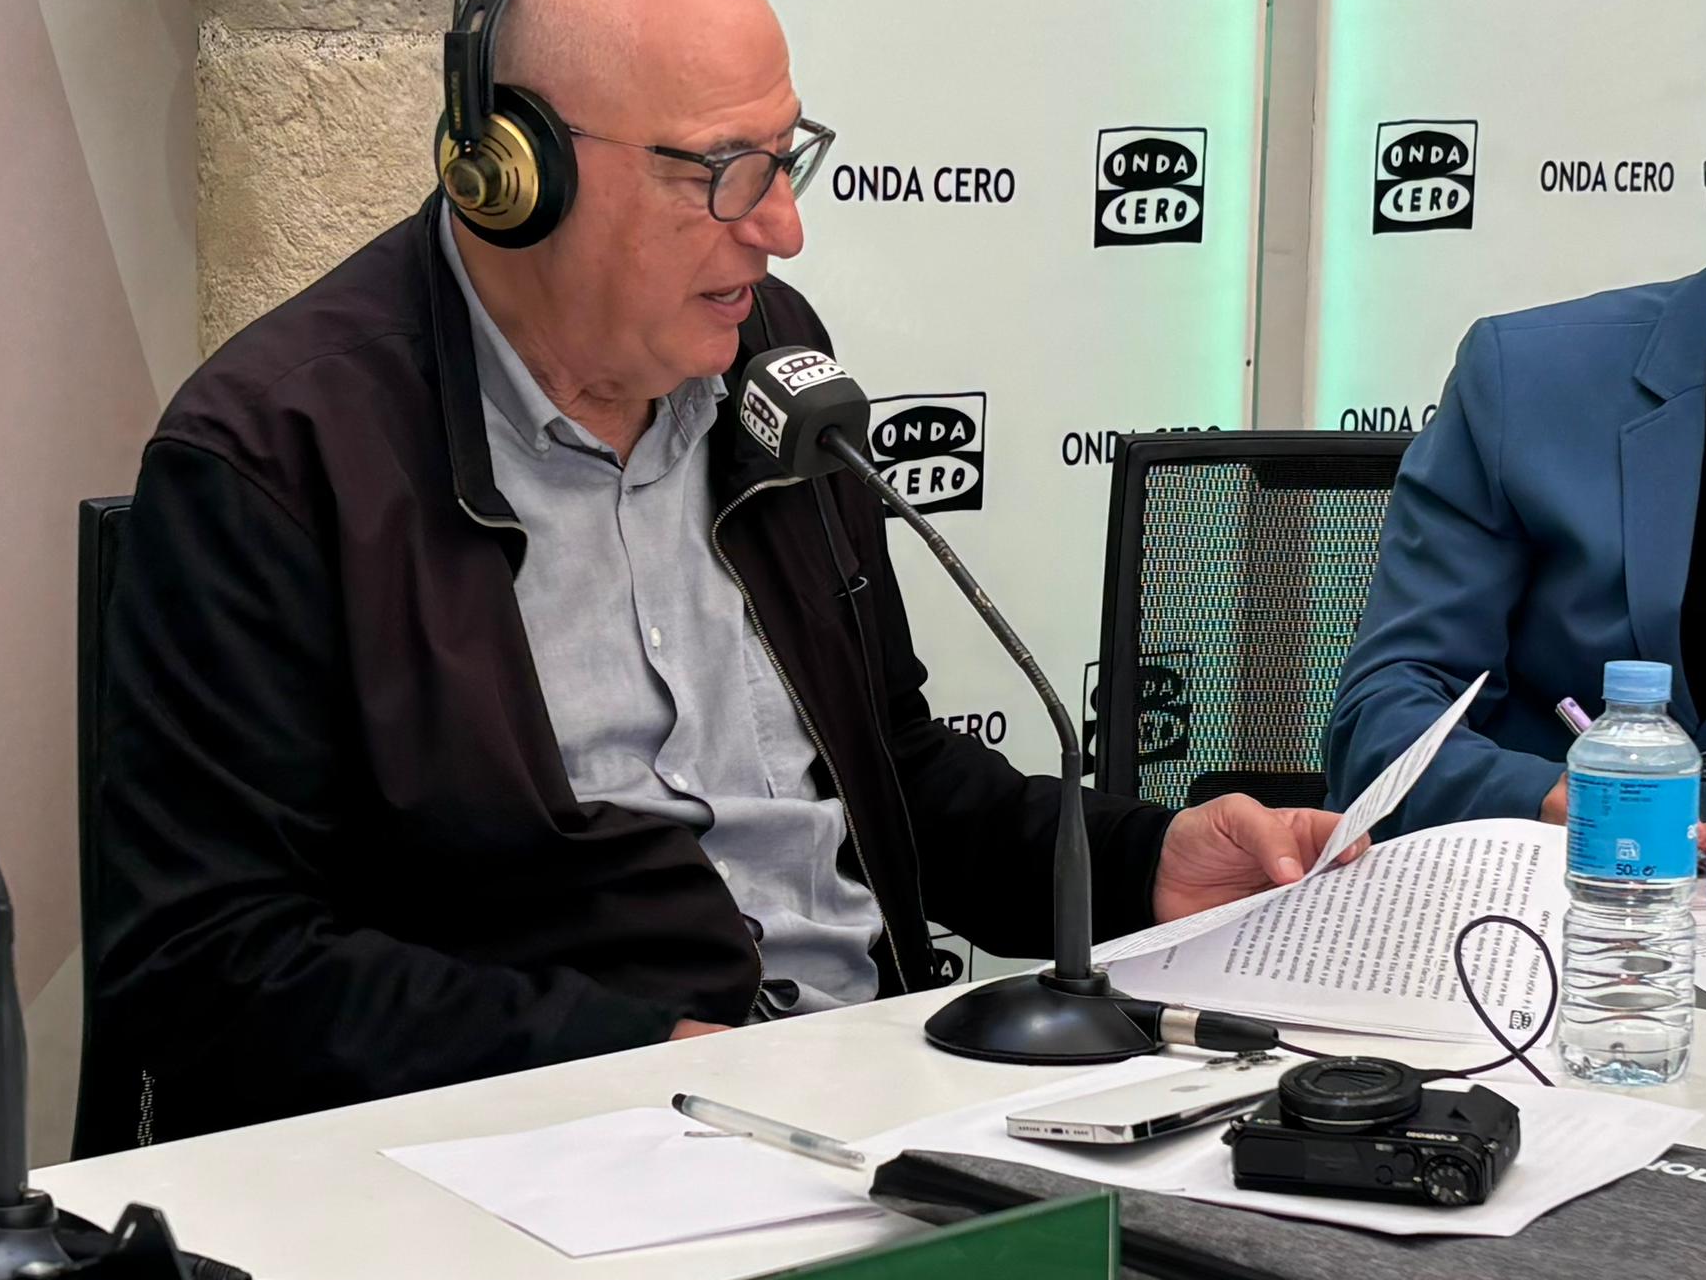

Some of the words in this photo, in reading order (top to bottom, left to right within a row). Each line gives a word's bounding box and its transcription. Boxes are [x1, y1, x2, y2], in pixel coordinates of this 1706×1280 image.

[1113, 152, 1189, 177] ONDA
[1390, 144, 1461, 168] ONDA
[832, 164, 924, 202] ONDA
[933, 166, 1016, 203] CERO
[1540, 160, 1607, 192] ONDA
[1614, 161, 1675, 193] CERO
[1115, 197, 1188, 225] CERO
[1392, 186, 1459, 213] CERO
[881, 420, 967, 447] ONDA
